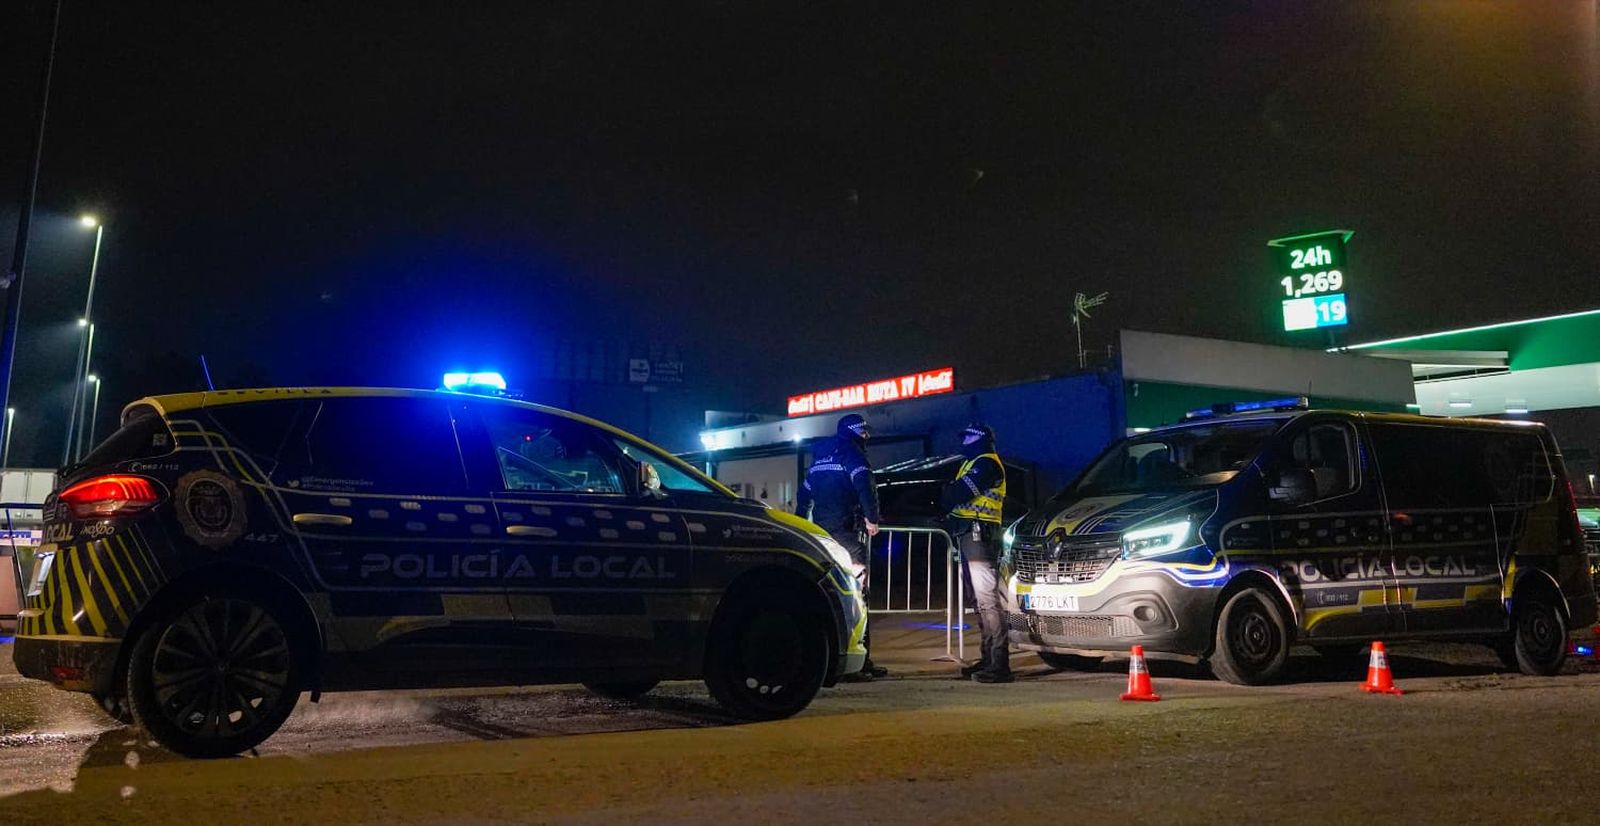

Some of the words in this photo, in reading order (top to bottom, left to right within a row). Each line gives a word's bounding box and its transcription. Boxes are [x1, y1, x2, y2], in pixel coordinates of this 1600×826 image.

[1290, 245, 1332, 269] 24h
[1281, 270, 1343, 298] 1,269
[361, 550, 536, 579] POLICÍA
[552, 555, 677, 578] LOCAL
[1392, 555, 1476, 576] LOCAL
[1031, 596, 1053, 608] 2776
[1057, 596, 1074, 608] LKT
